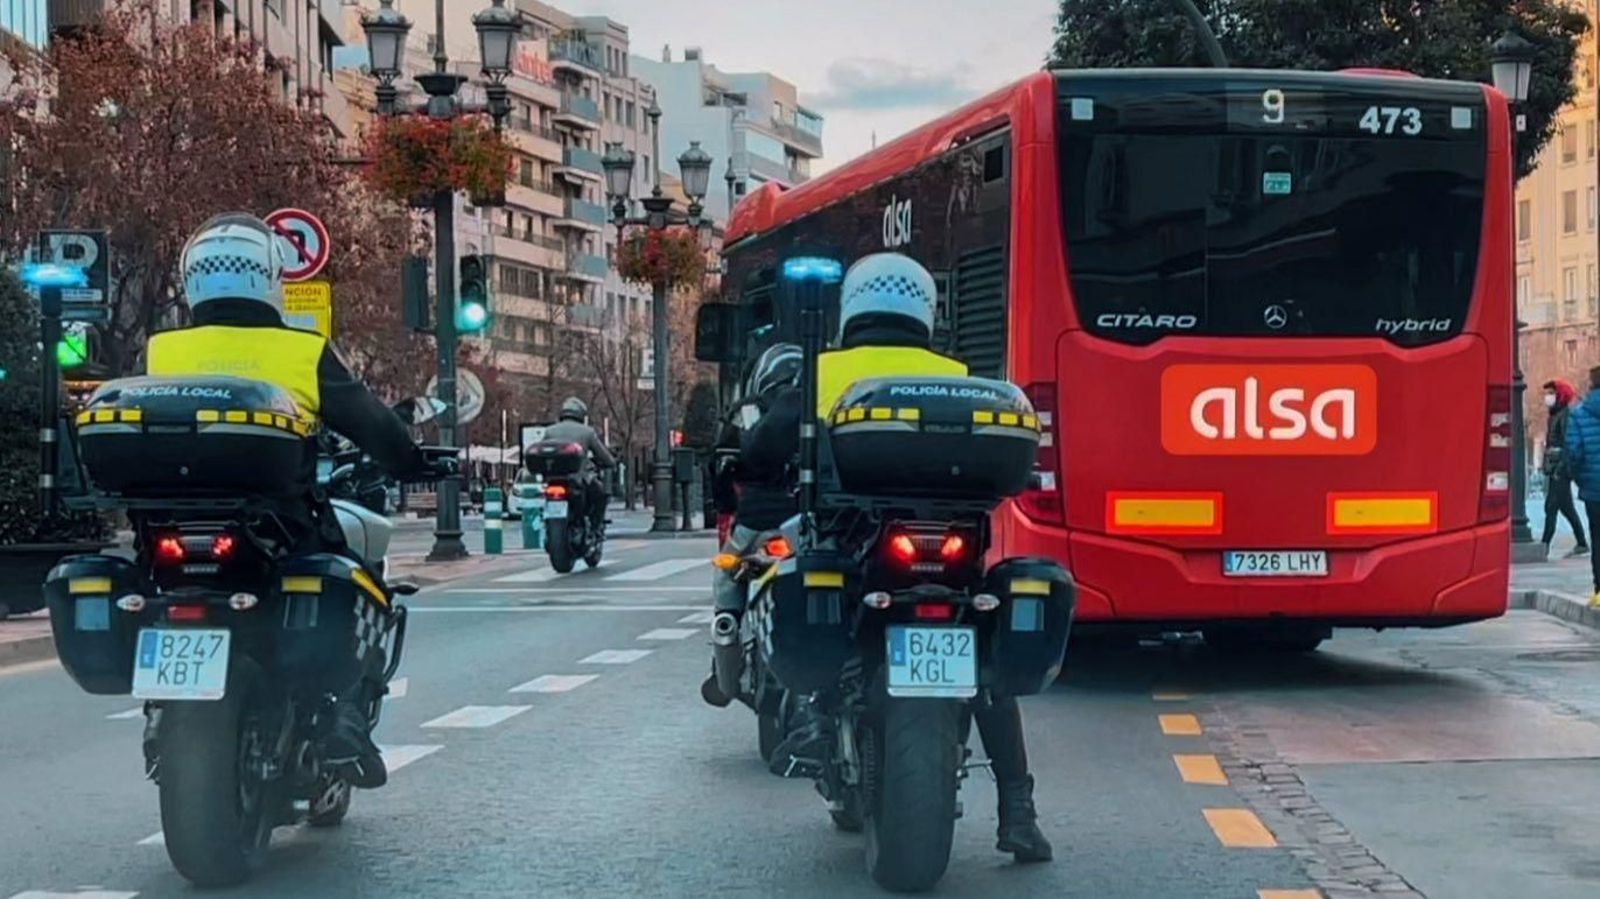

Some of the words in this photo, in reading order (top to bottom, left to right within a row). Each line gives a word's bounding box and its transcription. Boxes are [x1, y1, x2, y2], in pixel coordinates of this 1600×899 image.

[1263, 89, 1285, 124] 9
[1359, 105, 1423, 135] 473
[883, 193, 912, 248] alsa
[1096, 313, 1197, 328] CITARO
[1375, 318, 1451, 335] hybrid
[181, 387, 232, 399] LOCAL
[890, 385, 948, 396] POLICÍA
[951, 387, 998, 400] LOCAL
[1190, 376, 1355, 440] alsa
[1234, 554, 1281, 571] 7326
[1287, 554, 1321, 571] LHY
[160, 634, 224, 660] 8247
[909, 632, 970, 657] 6432
[156, 661, 204, 686] KBT
[910, 659, 956, 684] KGL
